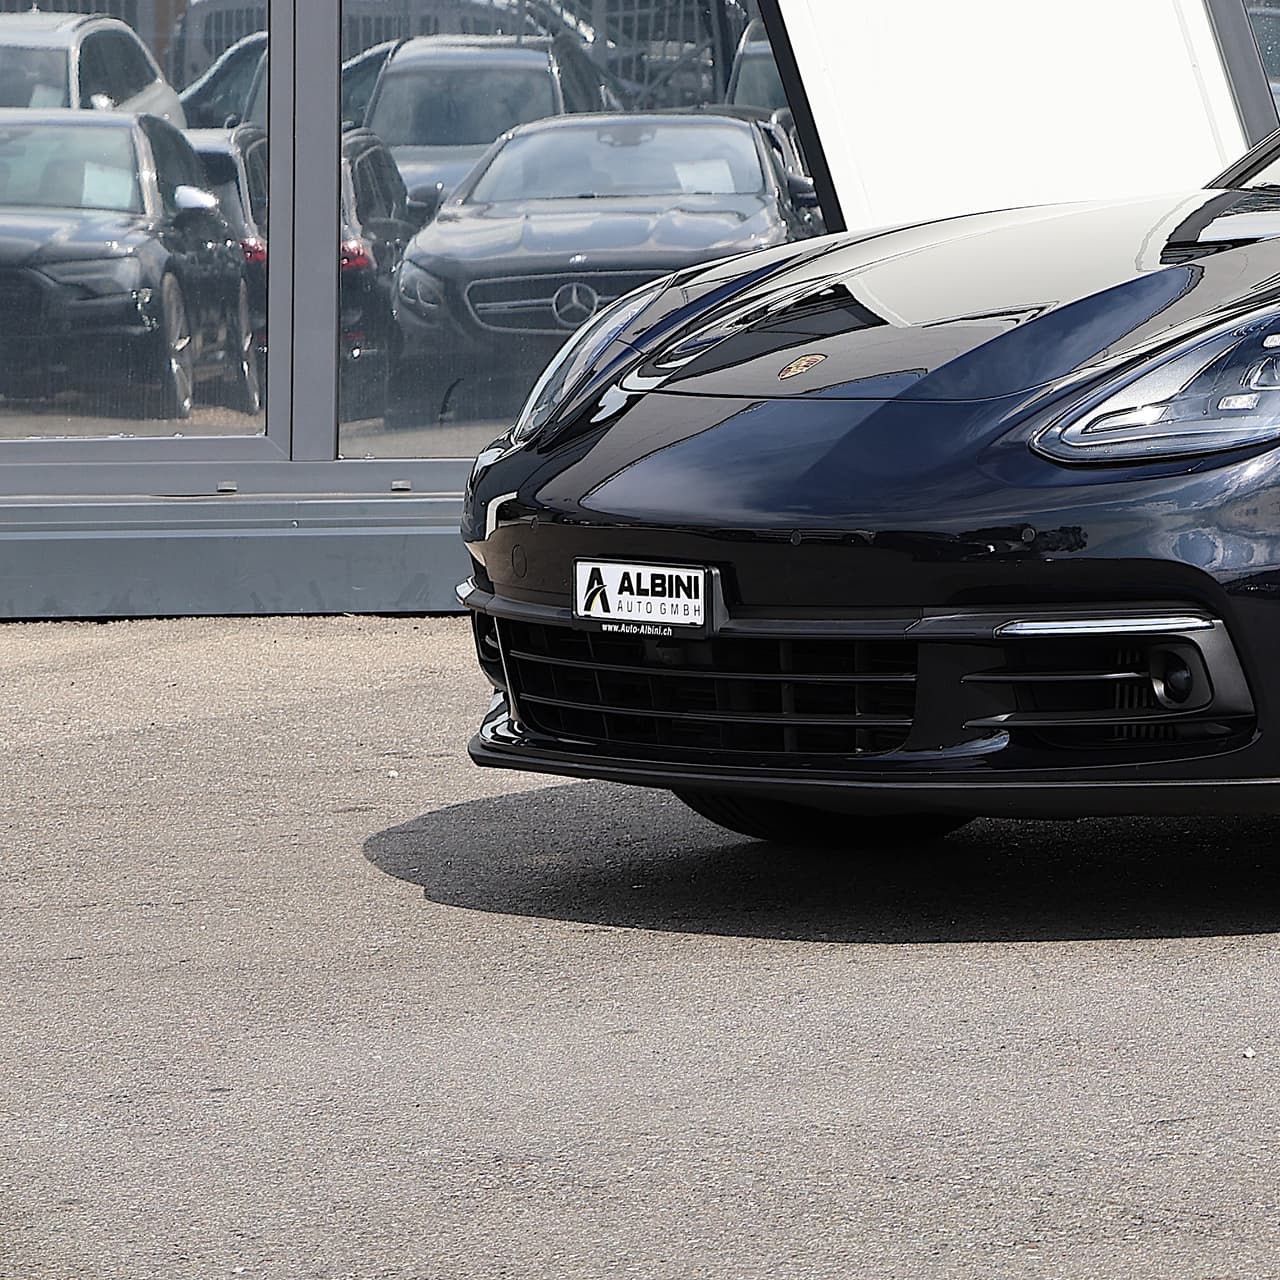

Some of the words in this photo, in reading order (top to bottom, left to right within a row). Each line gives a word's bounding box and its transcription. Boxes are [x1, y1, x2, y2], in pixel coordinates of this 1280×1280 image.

[617, 571, 700, 600] ALBINI
[616, 599, 653, 614] AUTO
[659, 602, 701, 617] GMBH
[601, 622, 673, 637] www.Auto-Albini.ch
